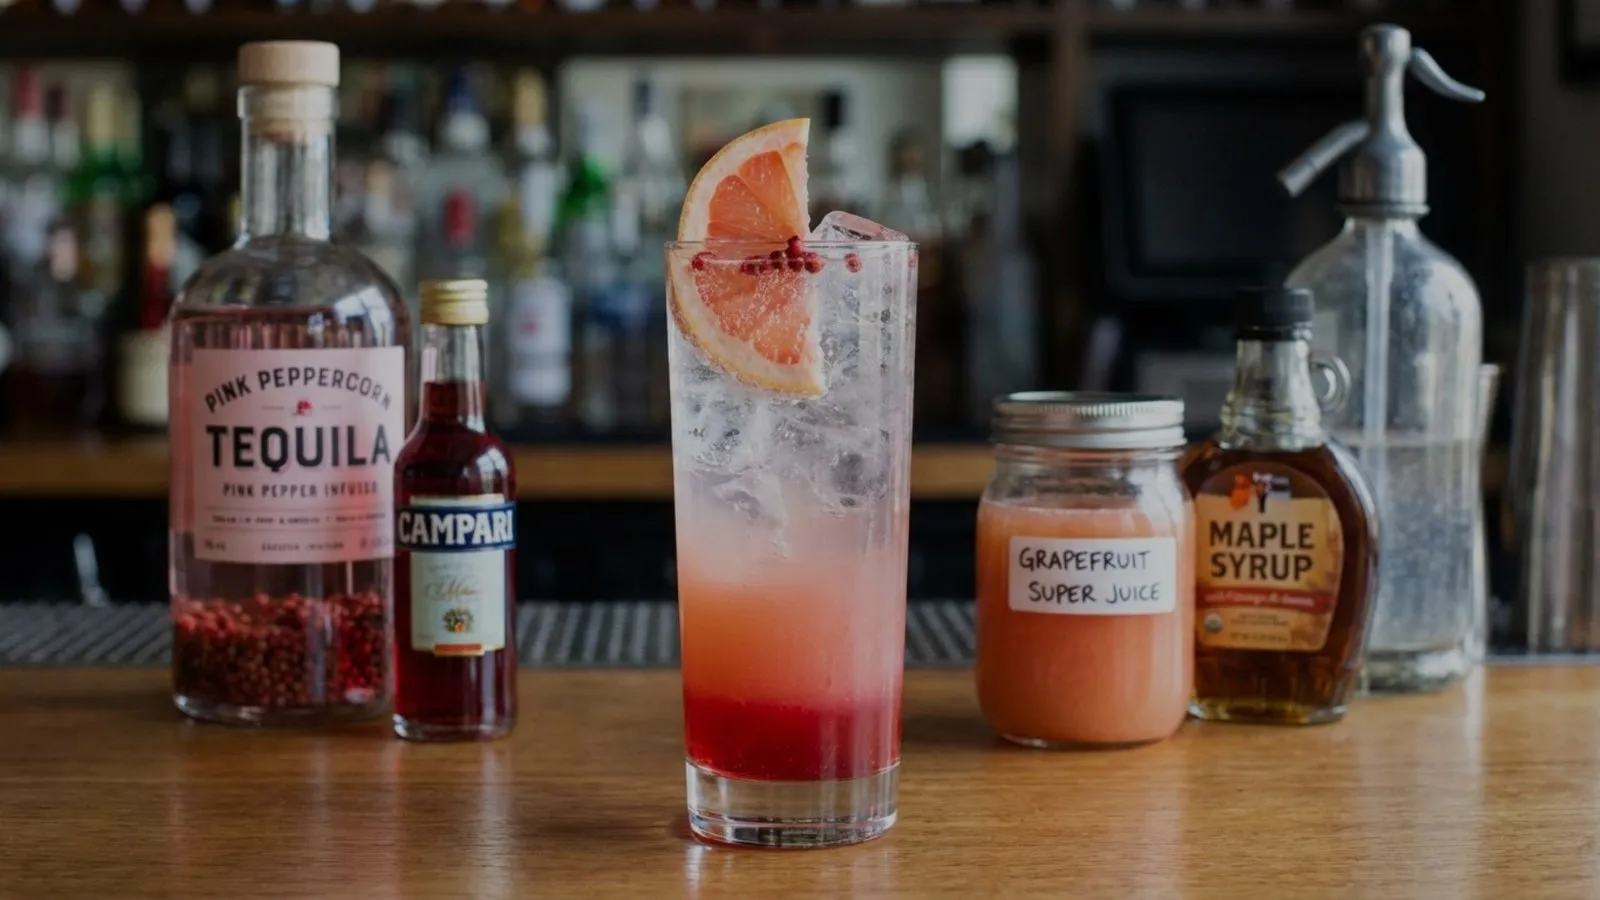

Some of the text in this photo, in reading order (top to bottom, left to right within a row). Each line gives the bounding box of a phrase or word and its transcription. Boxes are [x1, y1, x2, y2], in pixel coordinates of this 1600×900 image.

[204, 367, 392, 414] PINK PEPPERCORN
[205, 424, 391, 473] TEQUILA
[223, 483, 254, 497] PINK
[262, 484, 317, 498] PEPPER
[399, 510, 513, 546] CAMPARI
[1209, 521, 1314, 550] MAPLE
[1018, 547, 1151, 572] GRAPEFRUIT
[1210, 552, 1313, 582] SYRUP
[1028, 580, 1161, 605] SUPER JUICE
